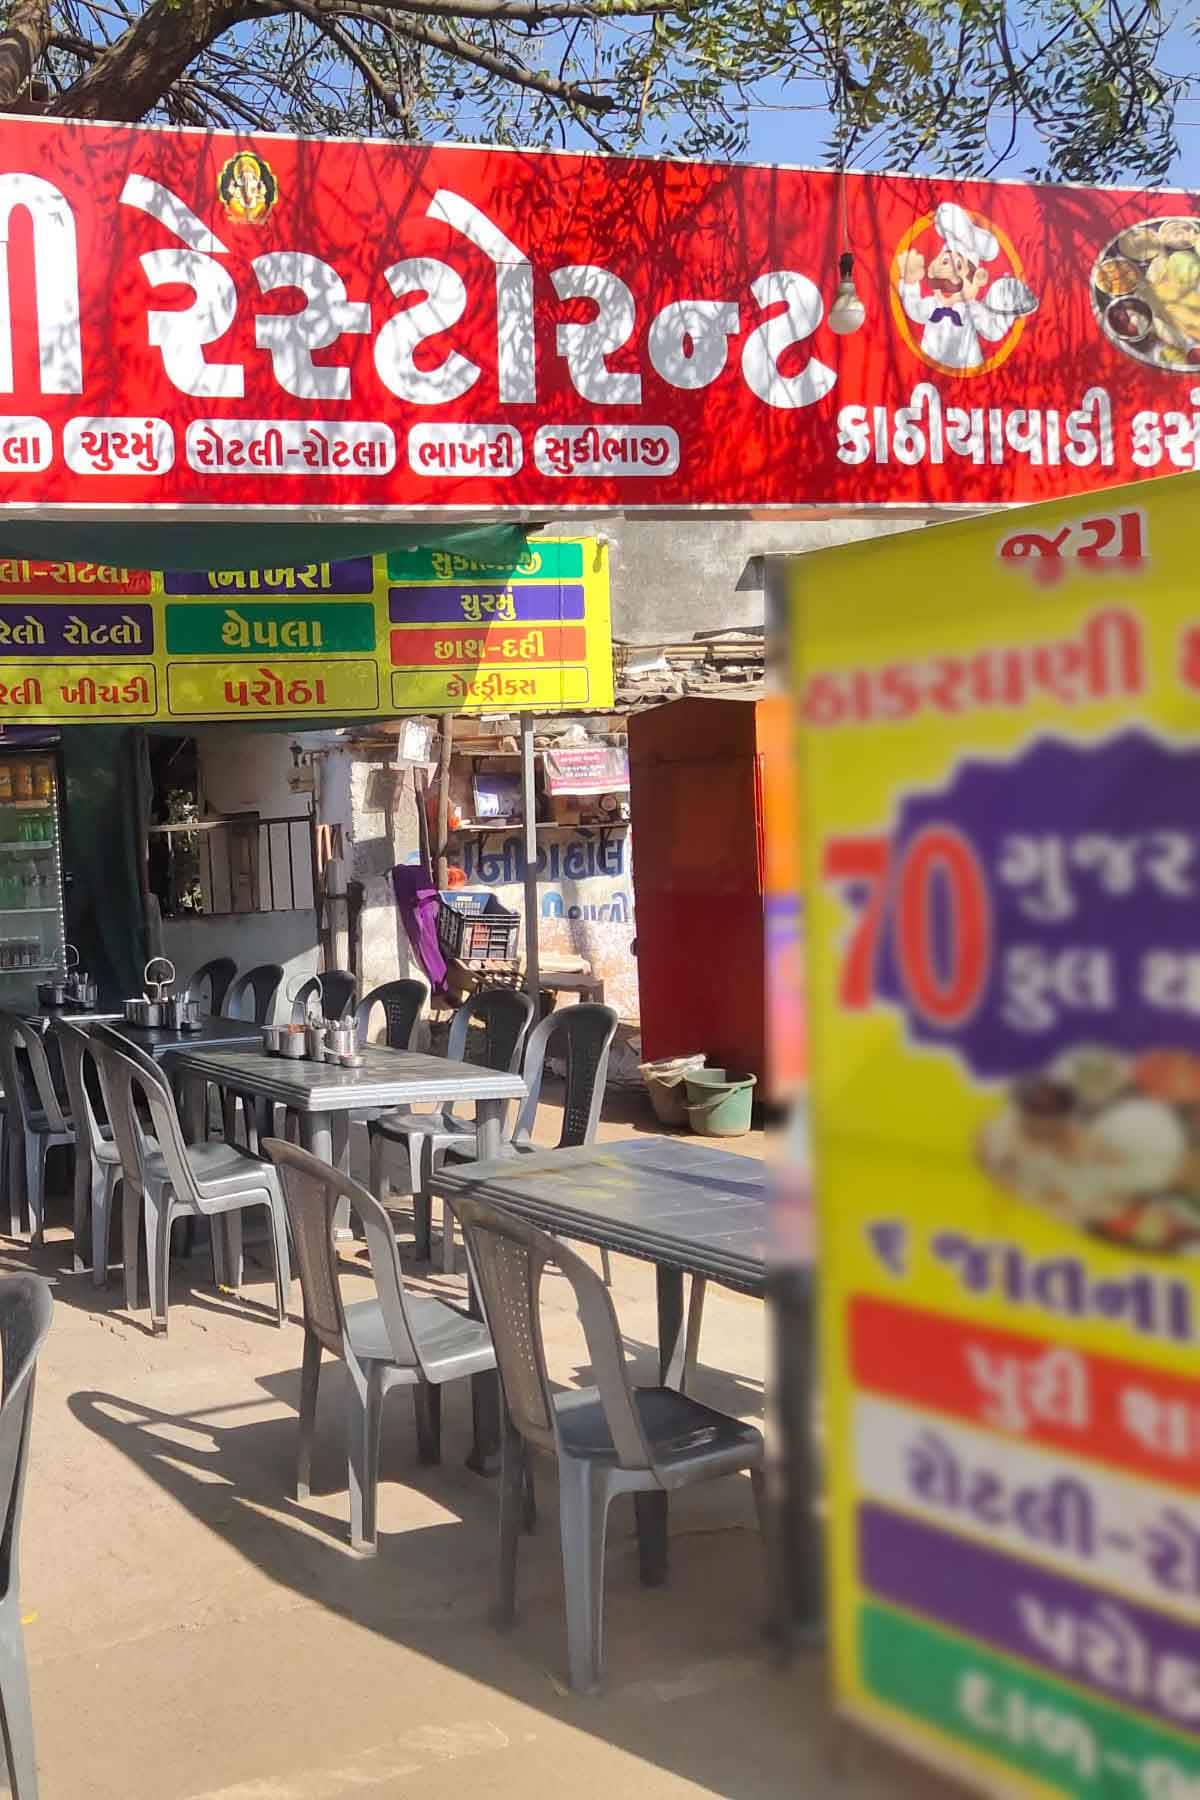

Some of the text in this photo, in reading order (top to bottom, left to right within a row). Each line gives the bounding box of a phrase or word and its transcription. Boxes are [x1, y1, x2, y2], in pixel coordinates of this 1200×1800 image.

[119, 173, 837, 409] રેસ્ટોરન્ટ
[836, 382, 1114, 466] કાઠીયાવાડી
[80, 420, 159, 471] ચુરમું
[196, 426, 387, 467] રોટલી-રોટલા
[418, 431, 514, 468] ભાખરી
[544, 427, 670, 475] સુકીભાજી
[63, 616, 143, 645] રોટલો
[221, 609, 324, 648] થેપલા
[59, 676, 151, 705] ખીચડી
[223, 667, 327, 706] પરોઠા
[821, 827, 988, 1024] 70
